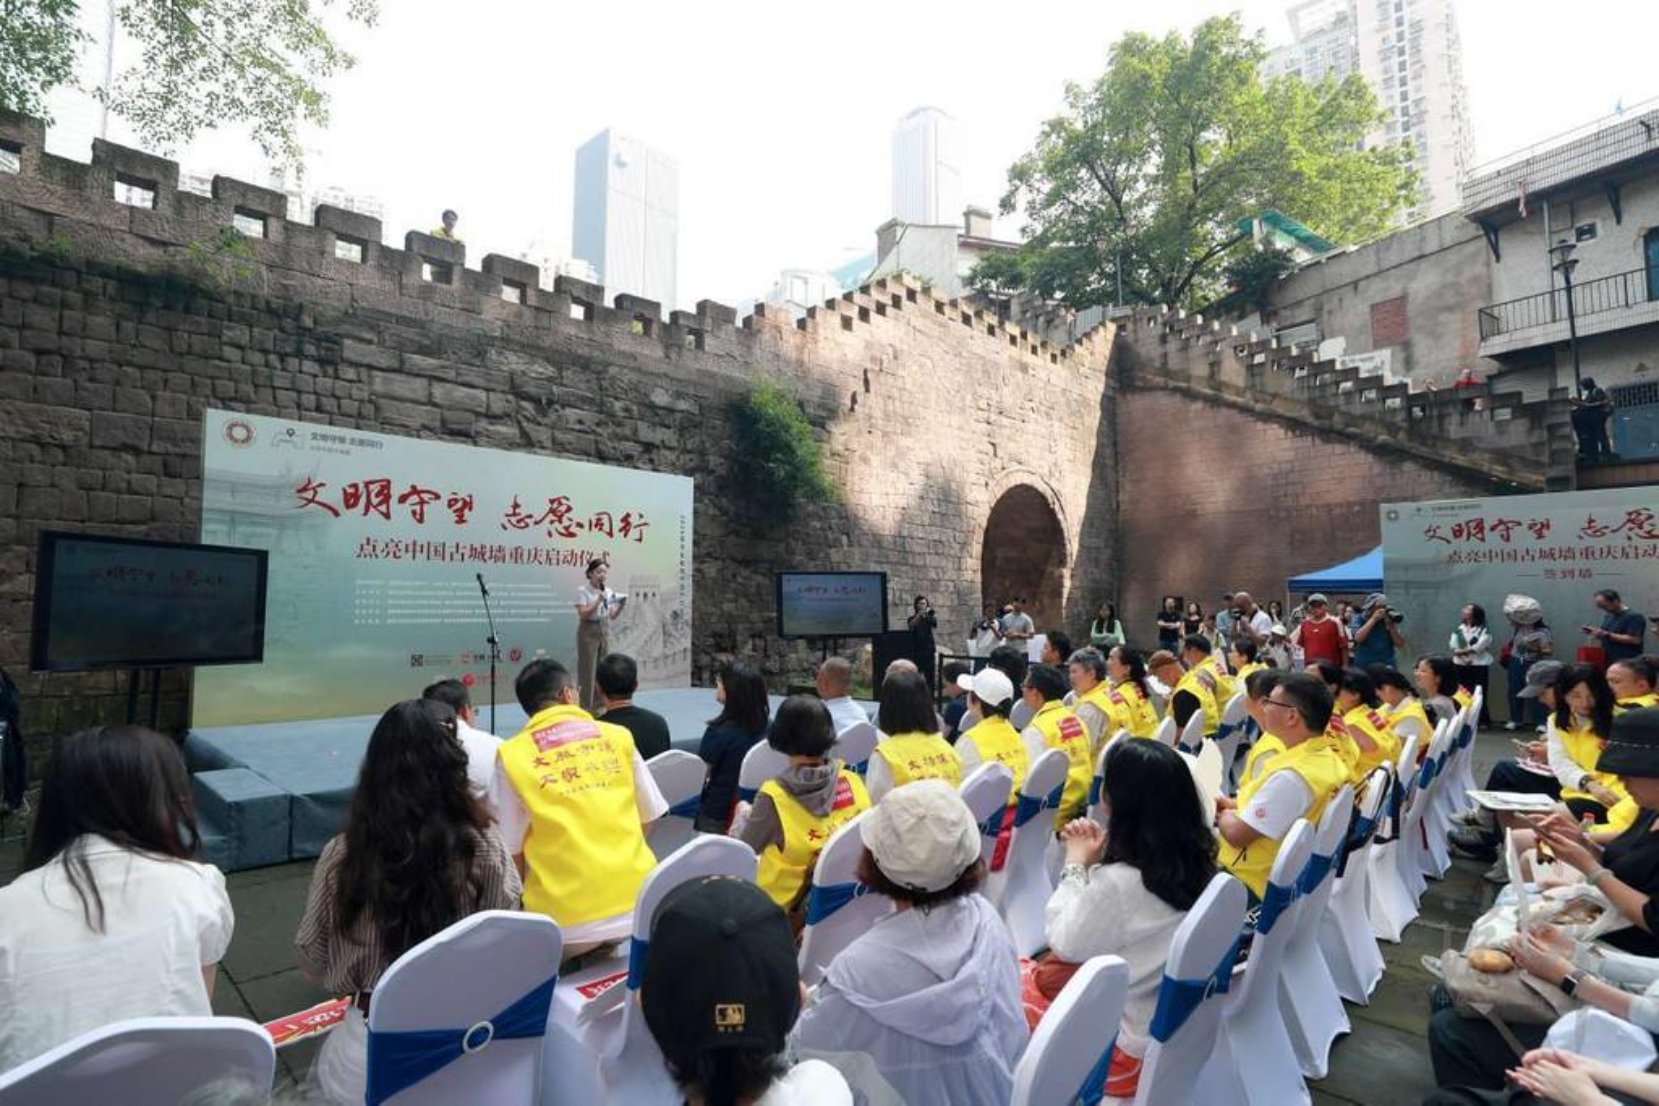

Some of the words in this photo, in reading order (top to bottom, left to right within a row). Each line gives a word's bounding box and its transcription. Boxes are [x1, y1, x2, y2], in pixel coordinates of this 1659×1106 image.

[295, 475, 474, 524] 文明守望
[501, 494, 650, 543] 志愿同行
[1424, 517, 1552, 544] 文明守望
